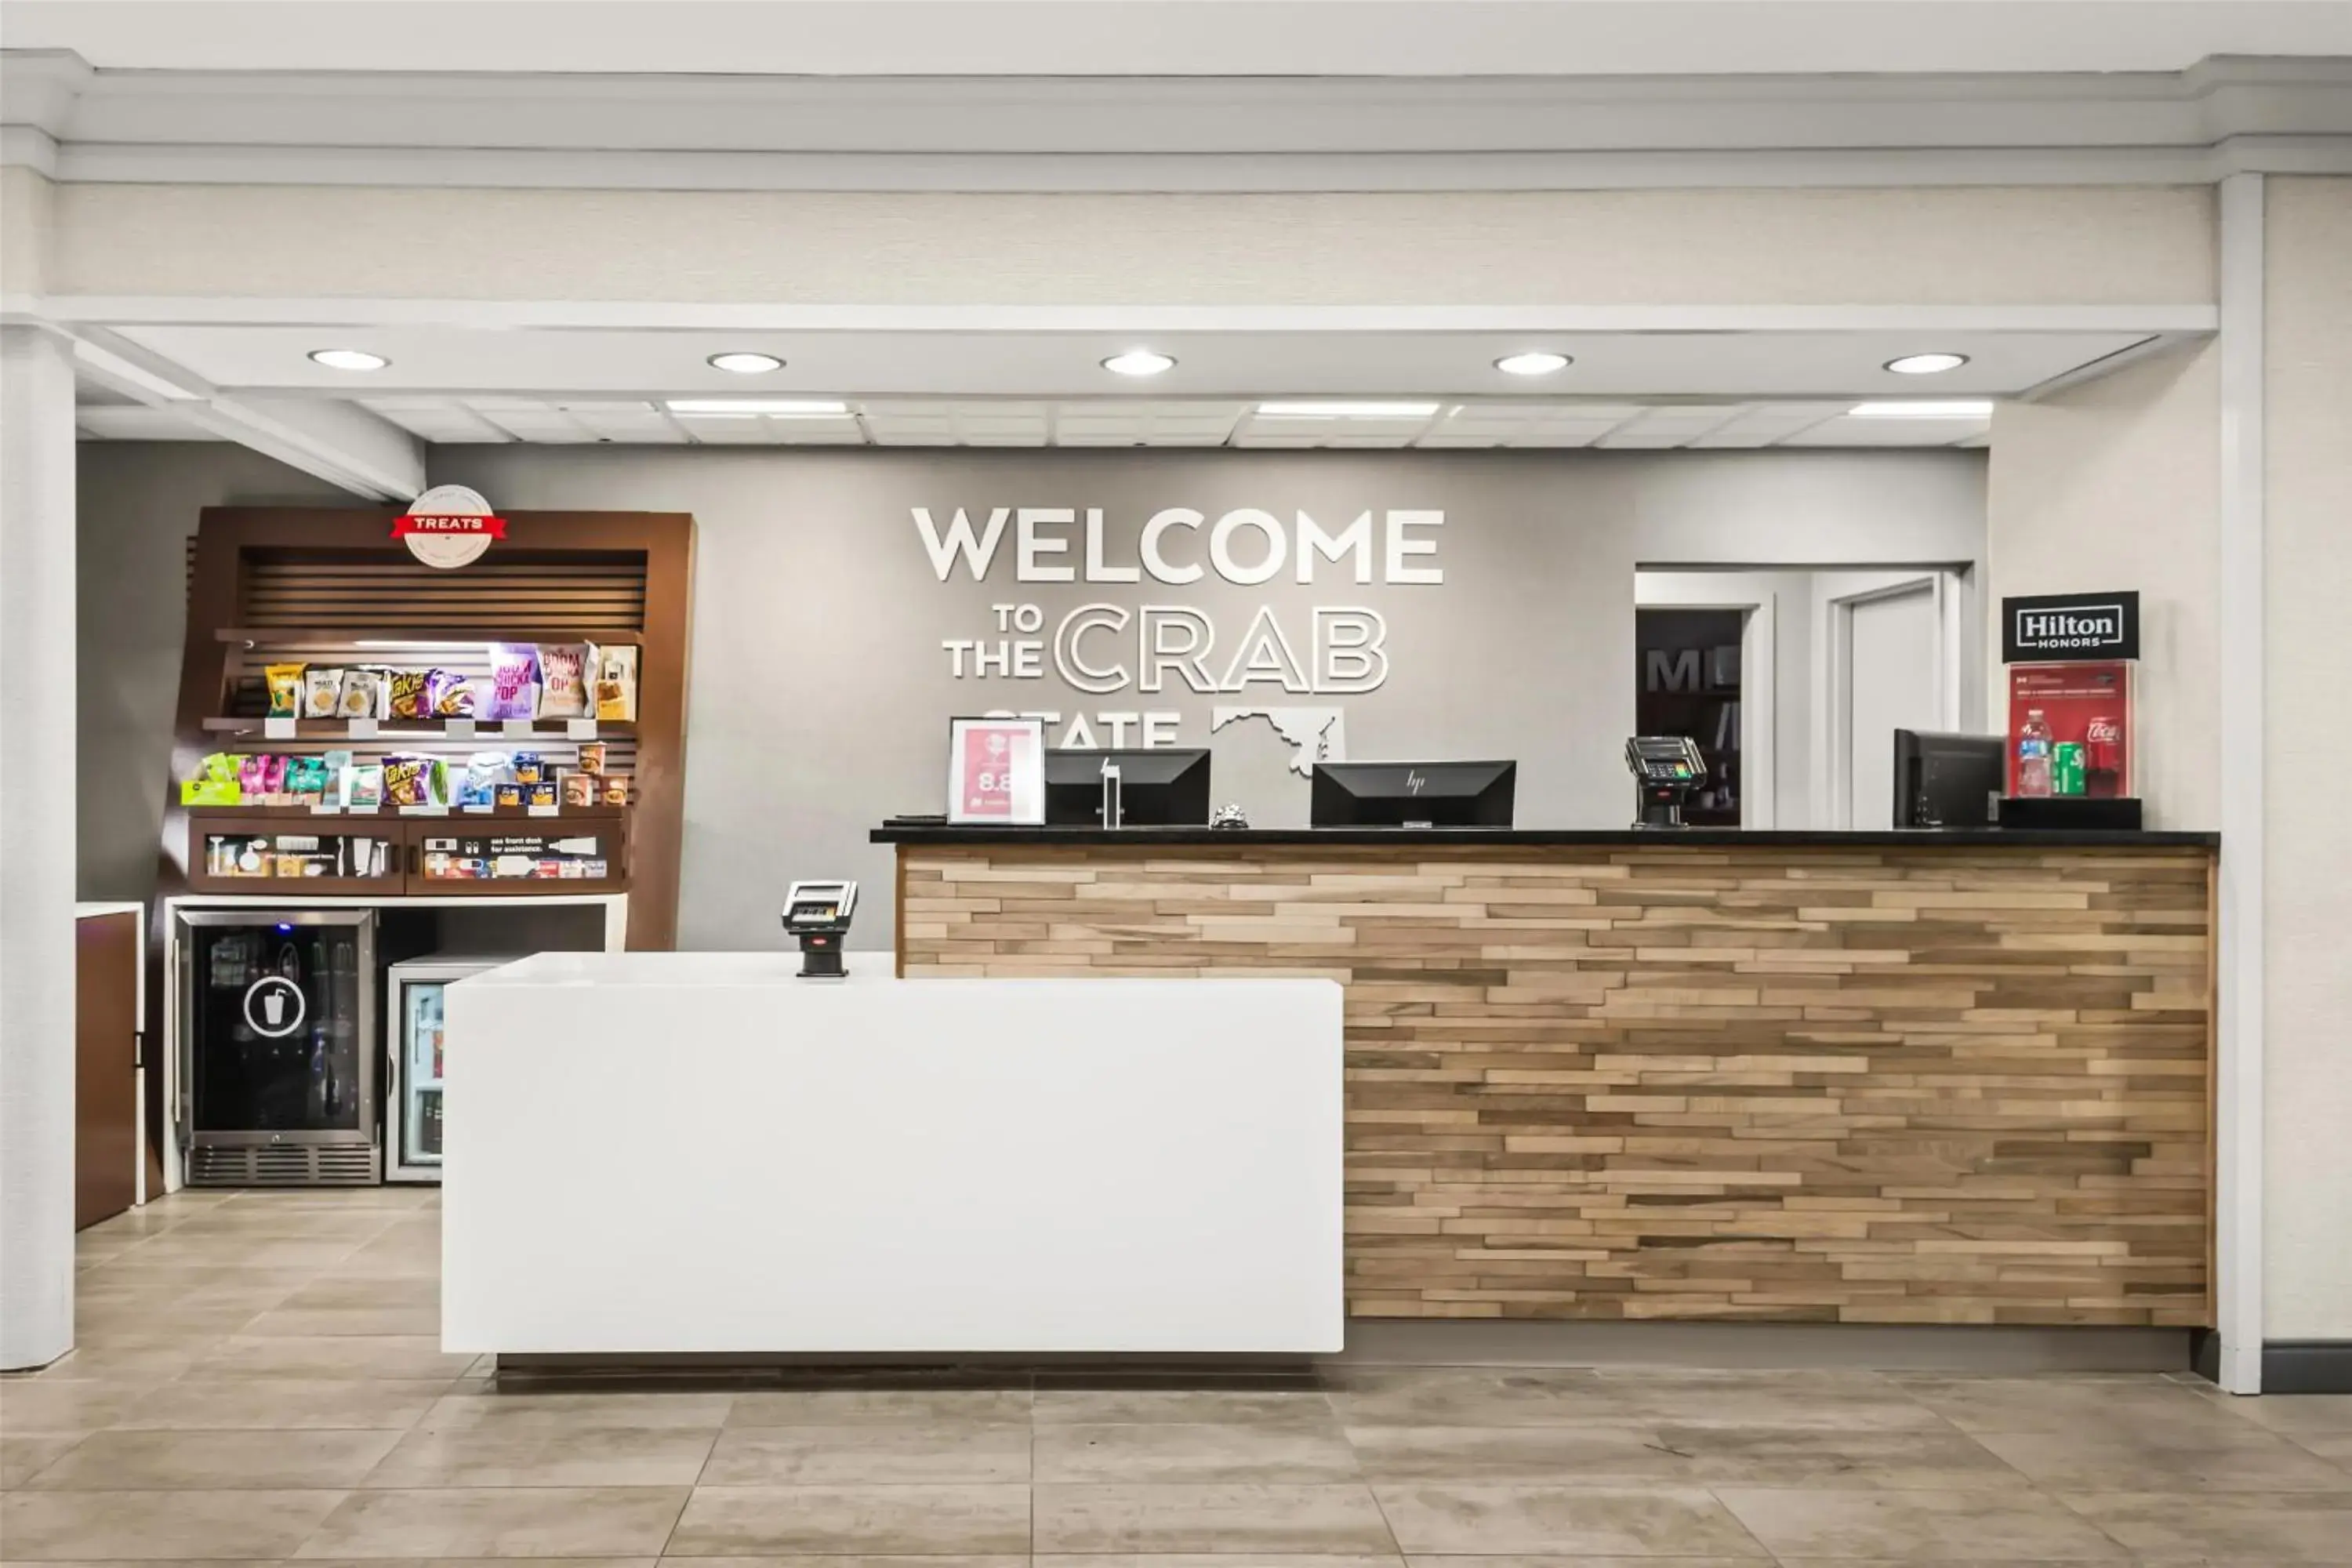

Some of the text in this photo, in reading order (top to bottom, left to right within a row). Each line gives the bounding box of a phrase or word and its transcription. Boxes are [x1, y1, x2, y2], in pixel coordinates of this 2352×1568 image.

[414, 517, 483, 529] TREATS
[910, 507, 1444, 585] WELCOME
[992, 603, 1044, 633] TO
[2026, 615, 2114, 637] Hilton
[942, 602, 1389, 694] THE CRAB
[2038, 637, 2100, 648] HONORS
[982, 710, 1181, 750] ATE
